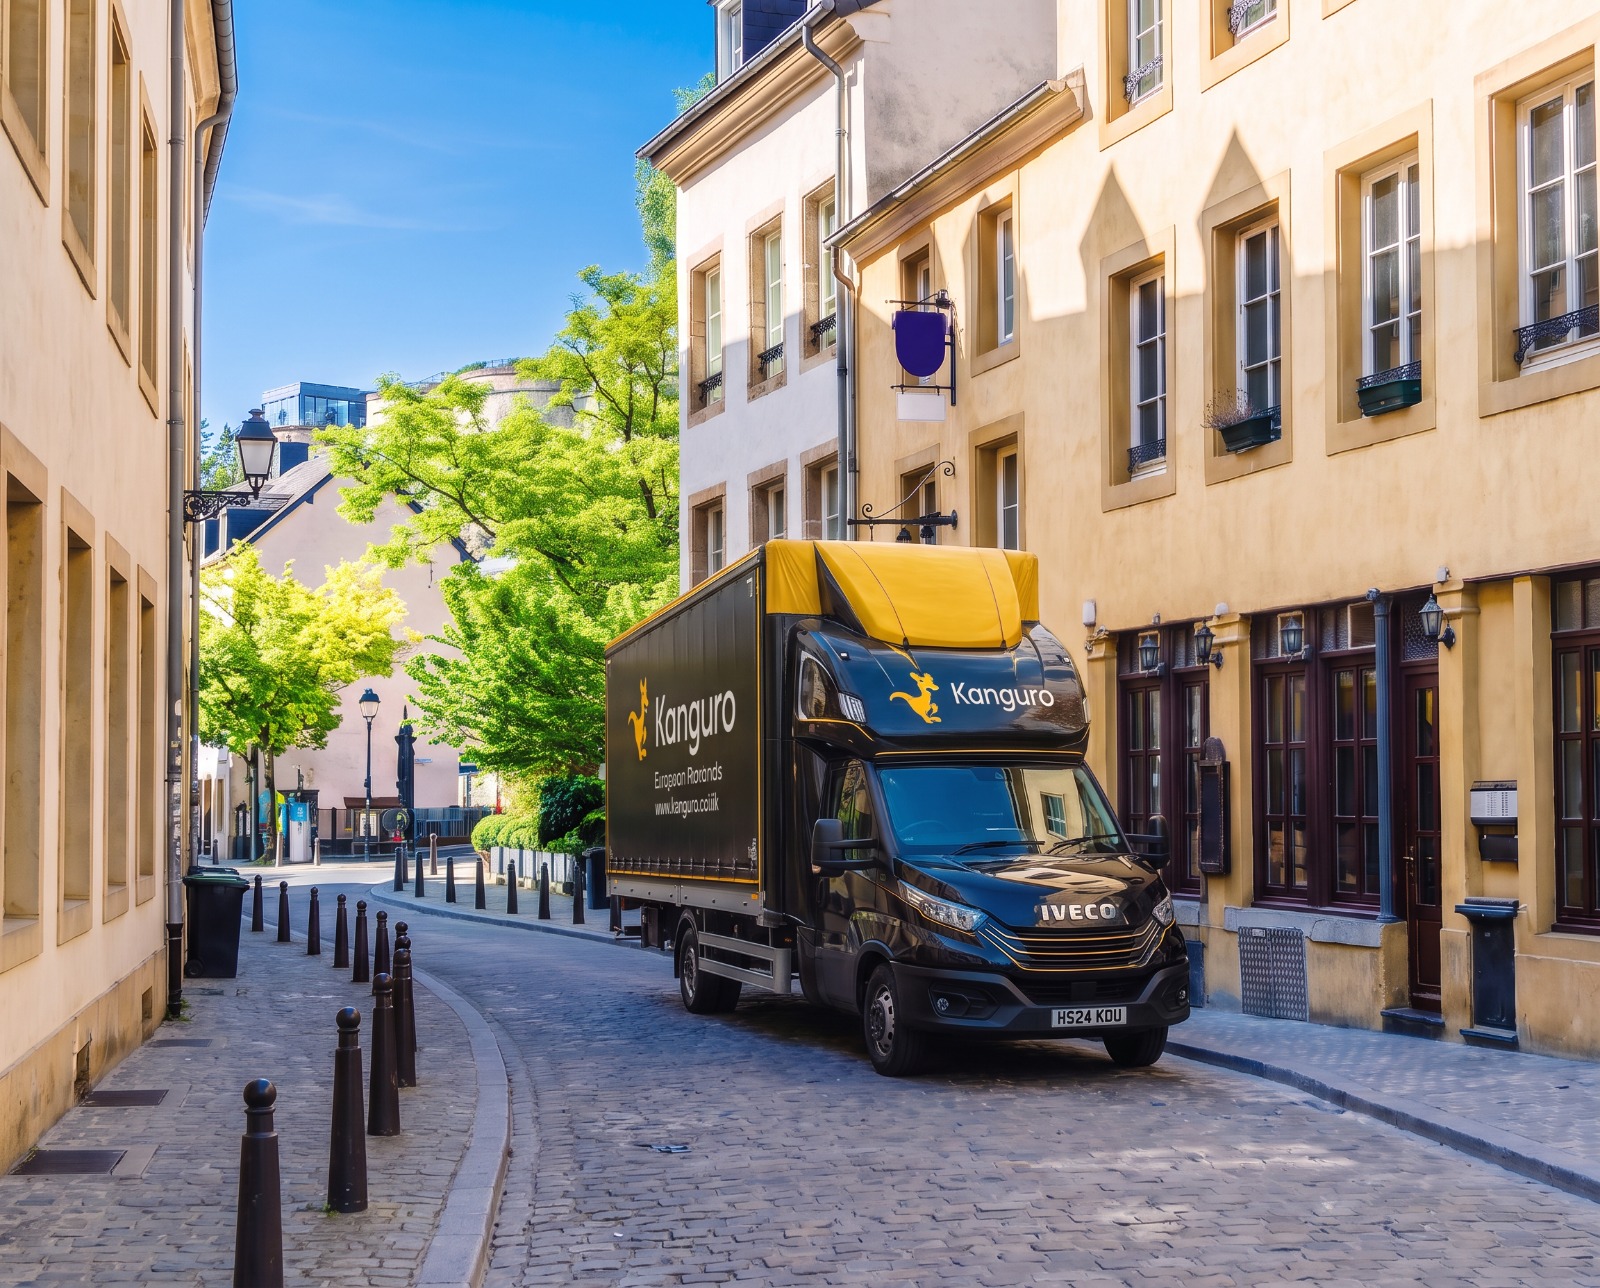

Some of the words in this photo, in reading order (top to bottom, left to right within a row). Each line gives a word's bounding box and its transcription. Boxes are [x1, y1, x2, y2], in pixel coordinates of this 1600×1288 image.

[950, 682, 1055, 712] Kanguro
[656, 690, 736, 756] Kanguro
[1041, 903, 1117, 921] IVECO
[1057, 1010, 1092, 1025] HS24
[1095, 1008, 1122, 1024] KDU
